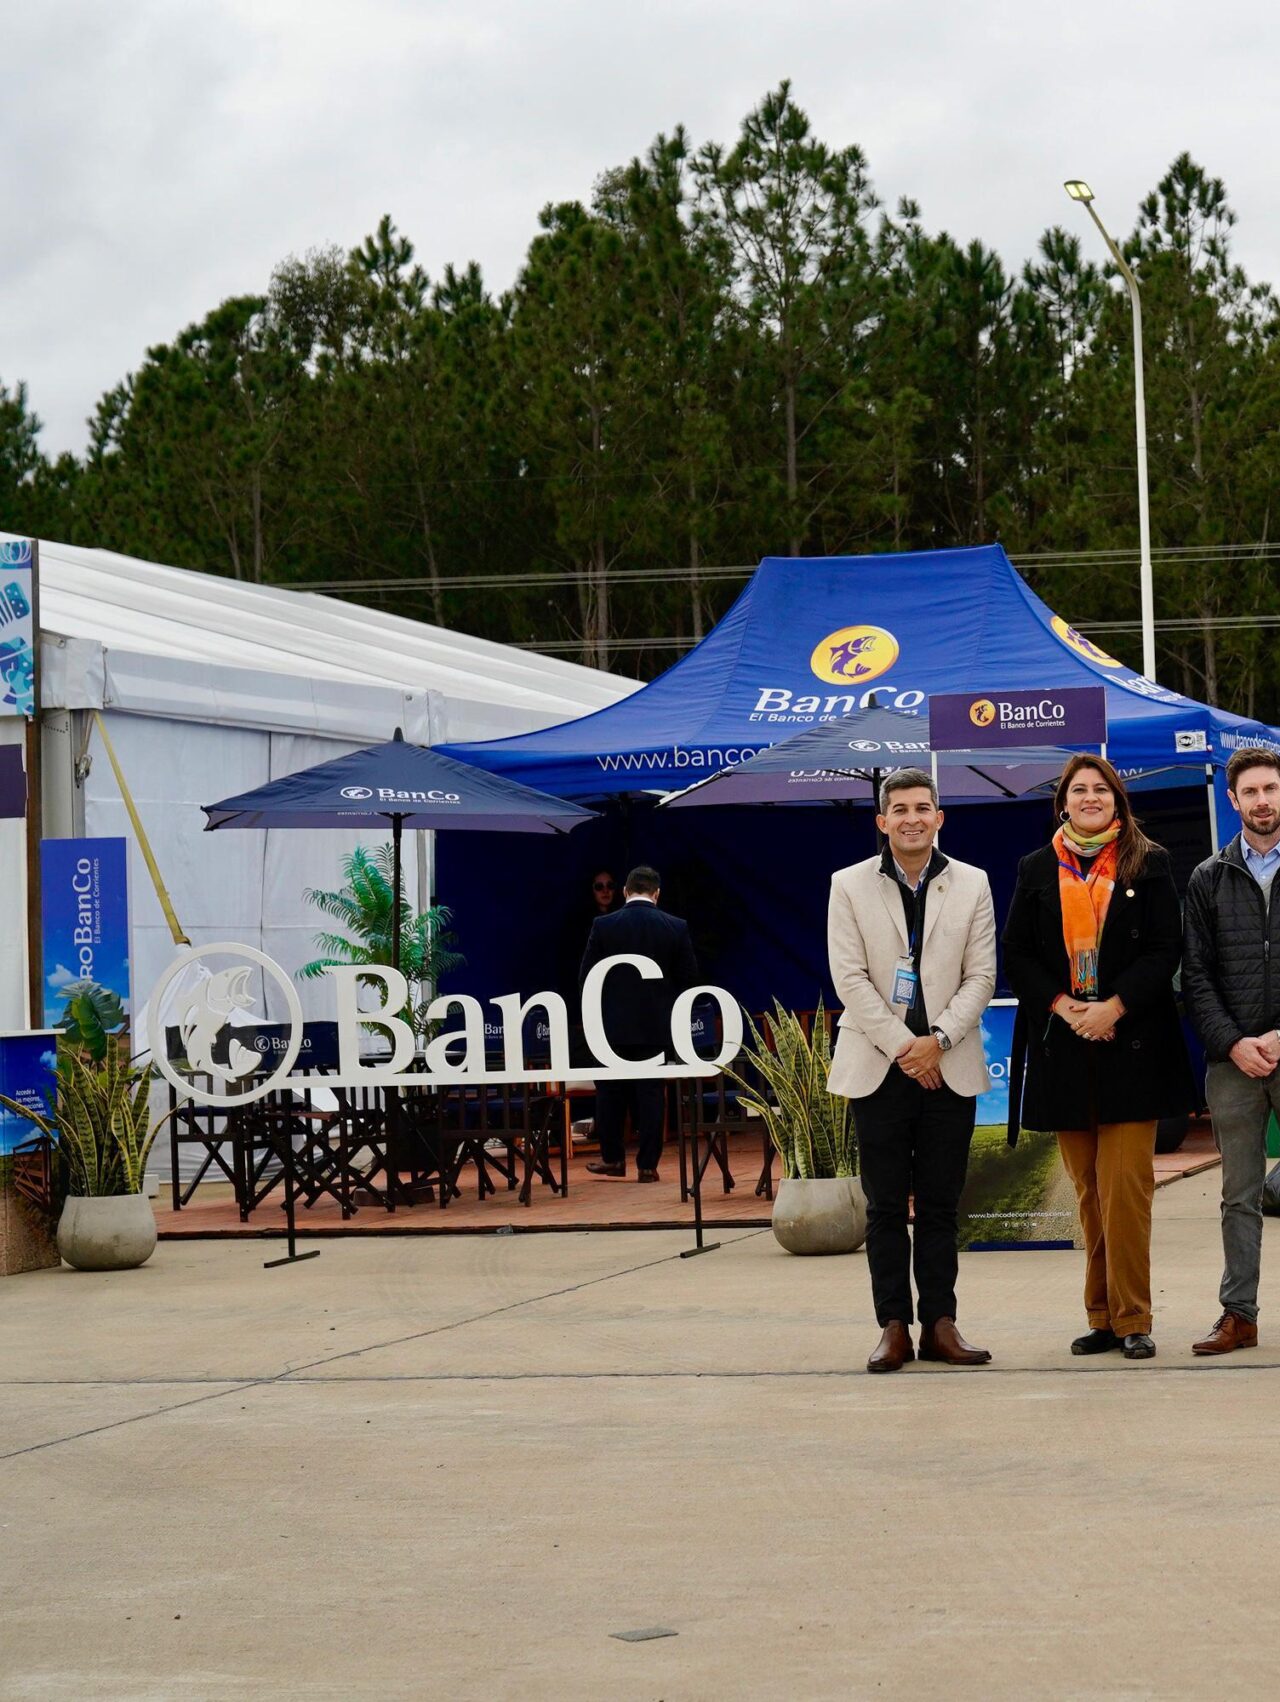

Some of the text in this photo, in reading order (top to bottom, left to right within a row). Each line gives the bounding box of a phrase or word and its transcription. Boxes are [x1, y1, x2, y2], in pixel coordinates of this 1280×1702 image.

[754, 686, 925, 713] BanCo
[749, 713, 763, 722] El
[767, 713, 815, 722] Banco
[818, 713, 838, 722] de
[998, 700, 1065, 721] BanCo
[1000, 719, 1066, 730] El Banco de Corrientes
[882, 741, 931, 750] Ban
[376, 788, 460, 801] BanCo
[92, 858, 100, 897] Corrientes
[93, 897, 100, 909] de
[72, 858, 94, 983] ROBanCo
[93, 910, 101, 935] Banco
[321, 953, 744, 1076] BanCo
[271, 1036, 312, 1049] Bao
